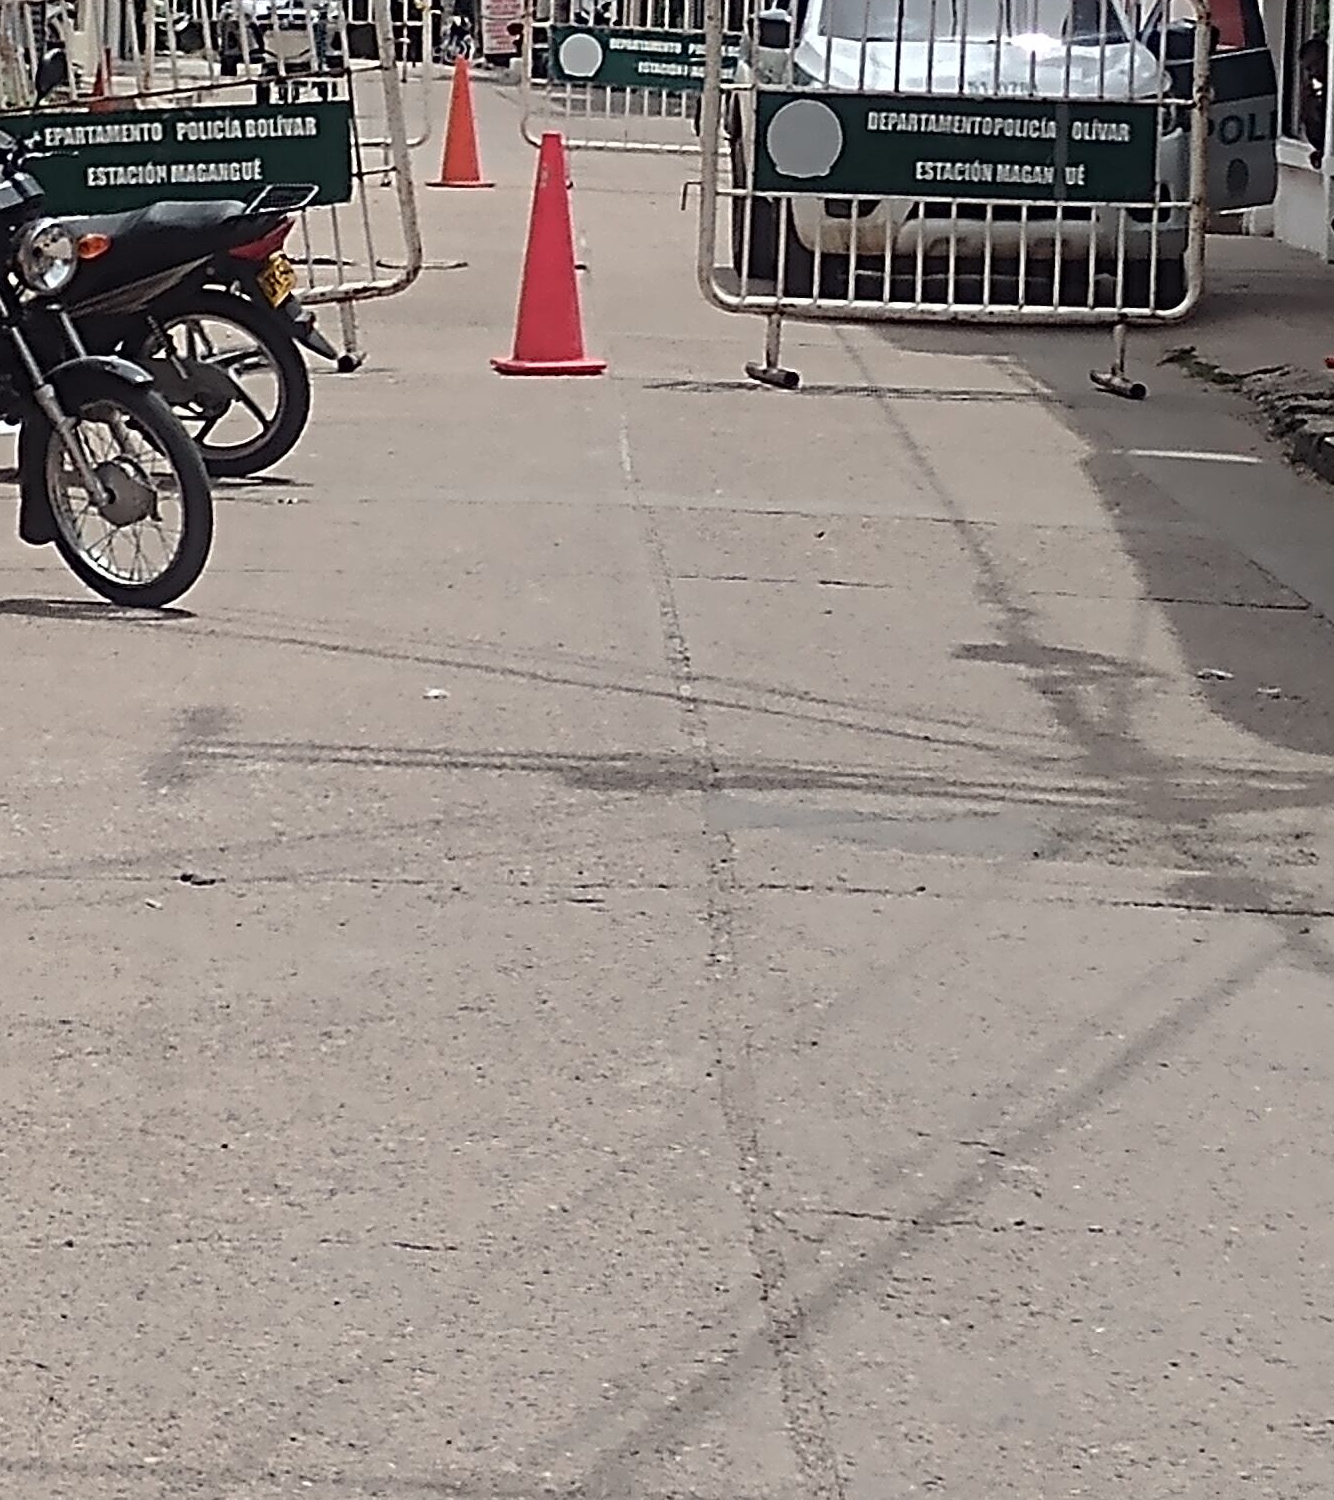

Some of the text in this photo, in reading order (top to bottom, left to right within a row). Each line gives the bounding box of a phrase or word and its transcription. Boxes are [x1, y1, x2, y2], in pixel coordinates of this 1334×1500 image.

[29, 115, 317, 148] EPARTAMENTO POLICÍA BOLÍVAR
[1071, 118, 1131, 142] OLÍVAR
[87, 157, 263, 187] ESTACIÓN MAGANGUÉ
[915, 159, 1085, 186] ESTACIÓN MAGANUÉ
